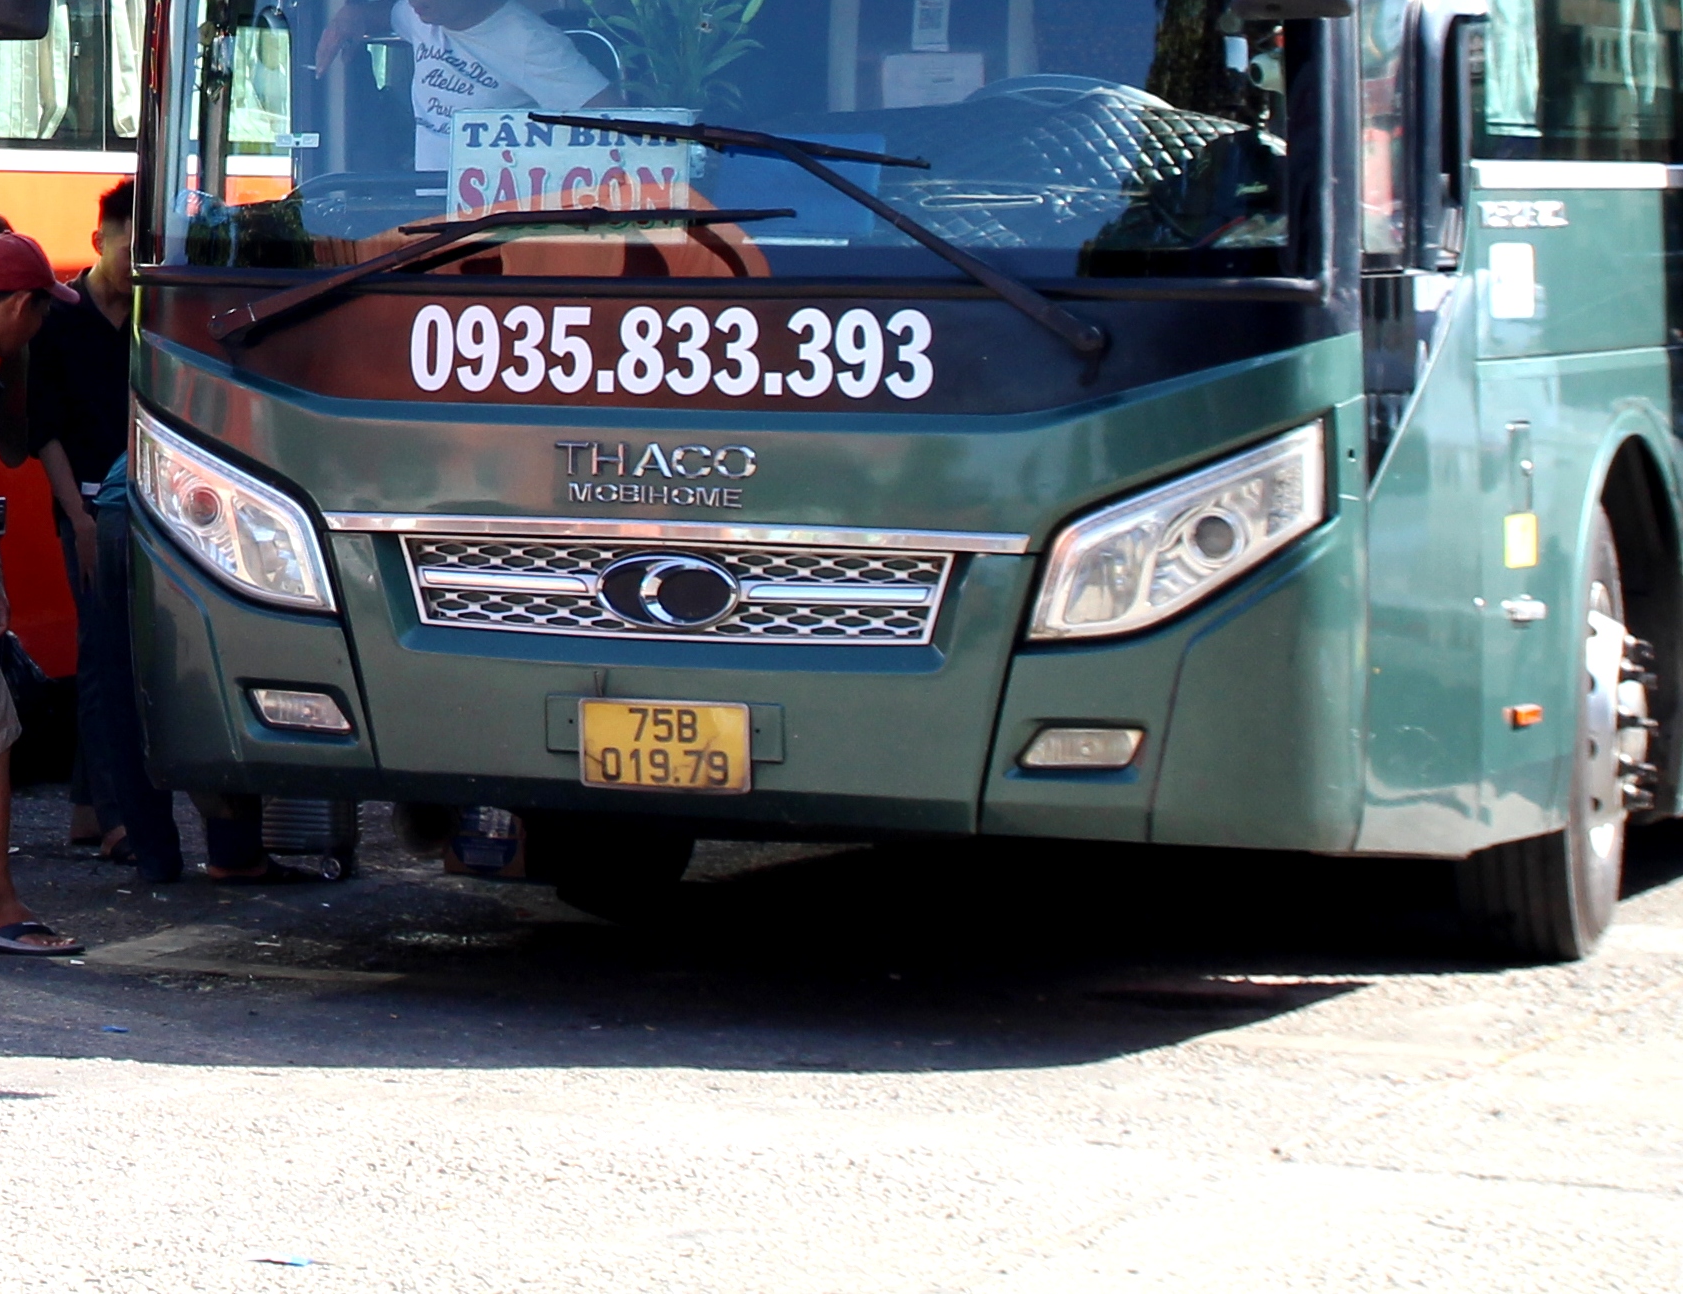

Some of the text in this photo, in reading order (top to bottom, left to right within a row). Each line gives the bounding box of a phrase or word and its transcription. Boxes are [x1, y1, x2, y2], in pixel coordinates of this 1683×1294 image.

[461, 114, 555, 148] TÂN
[457, 149, 676, 226] SÀI GÒN
[410, 304, 935, 401] 0935.833.393
[554, 440, 759, 480] THACO
[567, 481, 744, 509] MOBIHOME
[628, 707, 699, 744] 75B
[600, 746, 730, 787] 019.79
